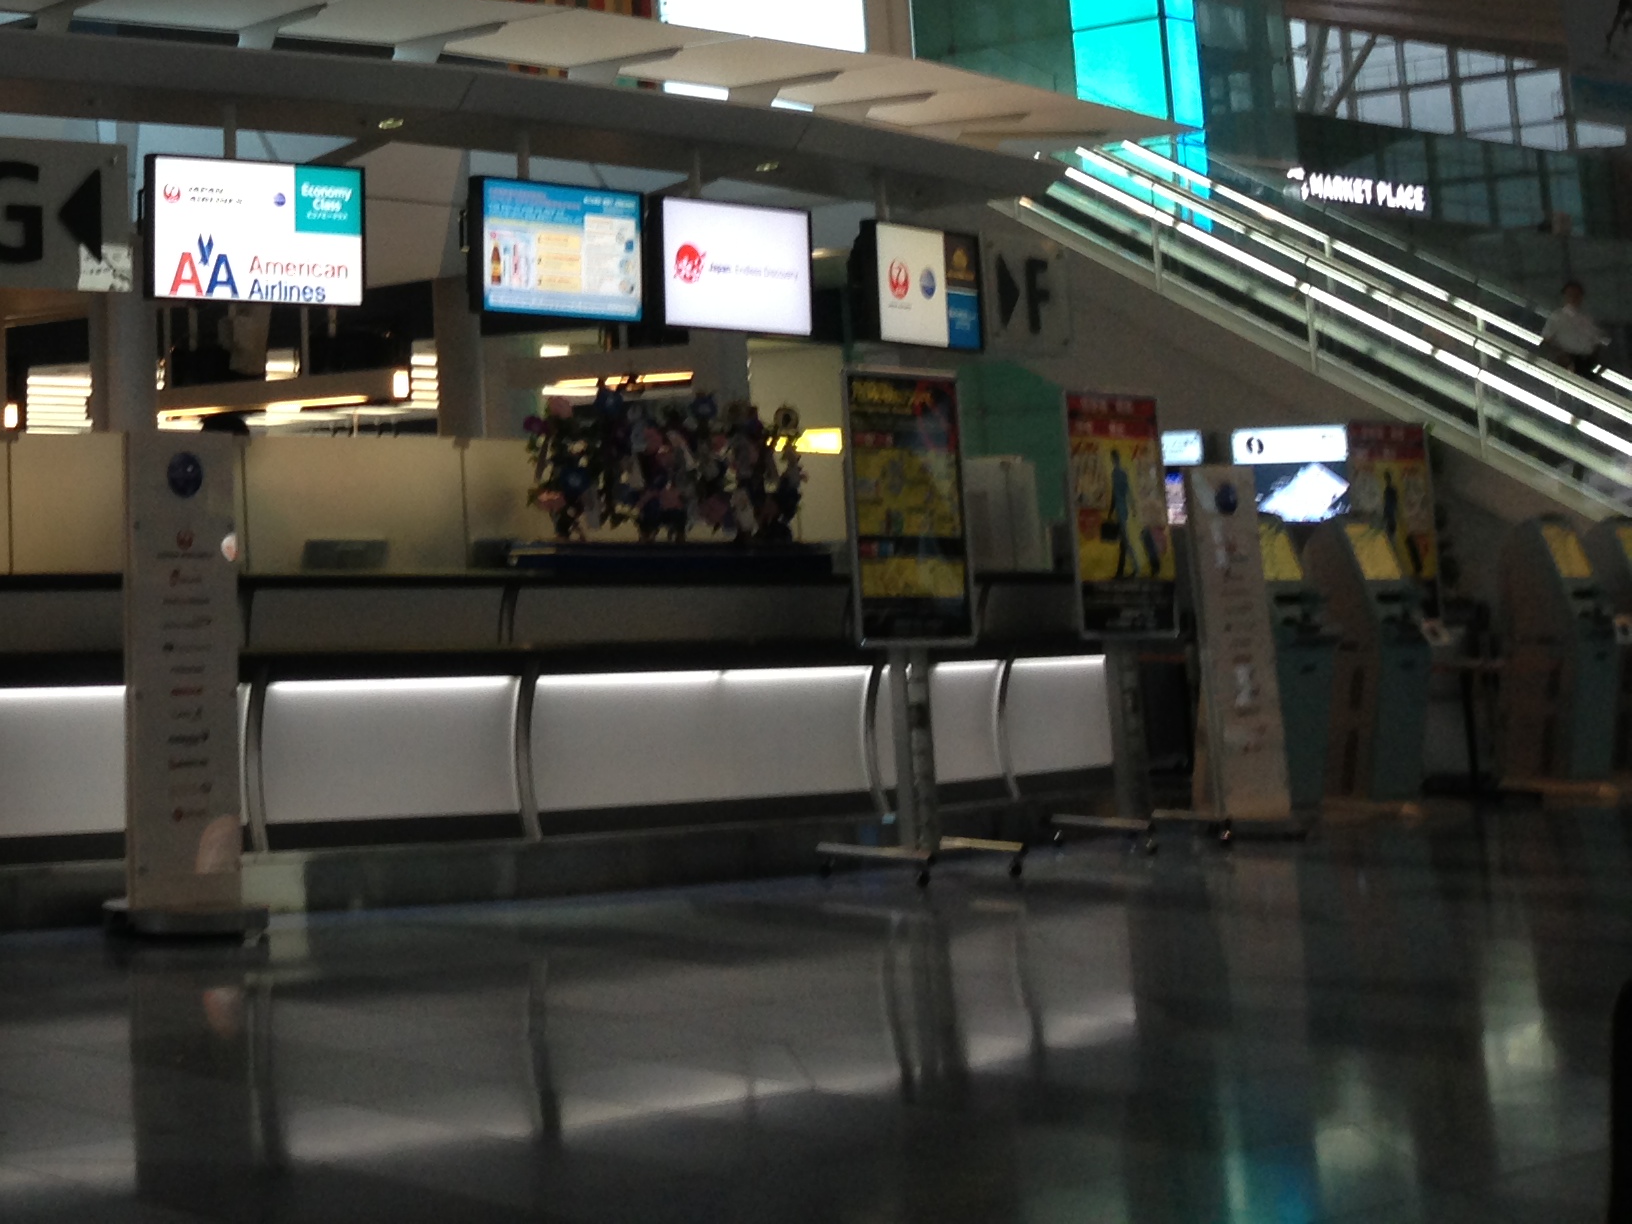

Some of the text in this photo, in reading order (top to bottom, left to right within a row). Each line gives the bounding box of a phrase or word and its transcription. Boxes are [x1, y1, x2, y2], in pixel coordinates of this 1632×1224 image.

[301, 181, 353, 202] Economy
[1309, 172, 1426, 211] MARKET PLACE
[312, 199, 343, 213] Class
[249, 255, 349, 279] American
[248, 278, 327, 303] Airlines
[1025, 258, 1050, 334] F
